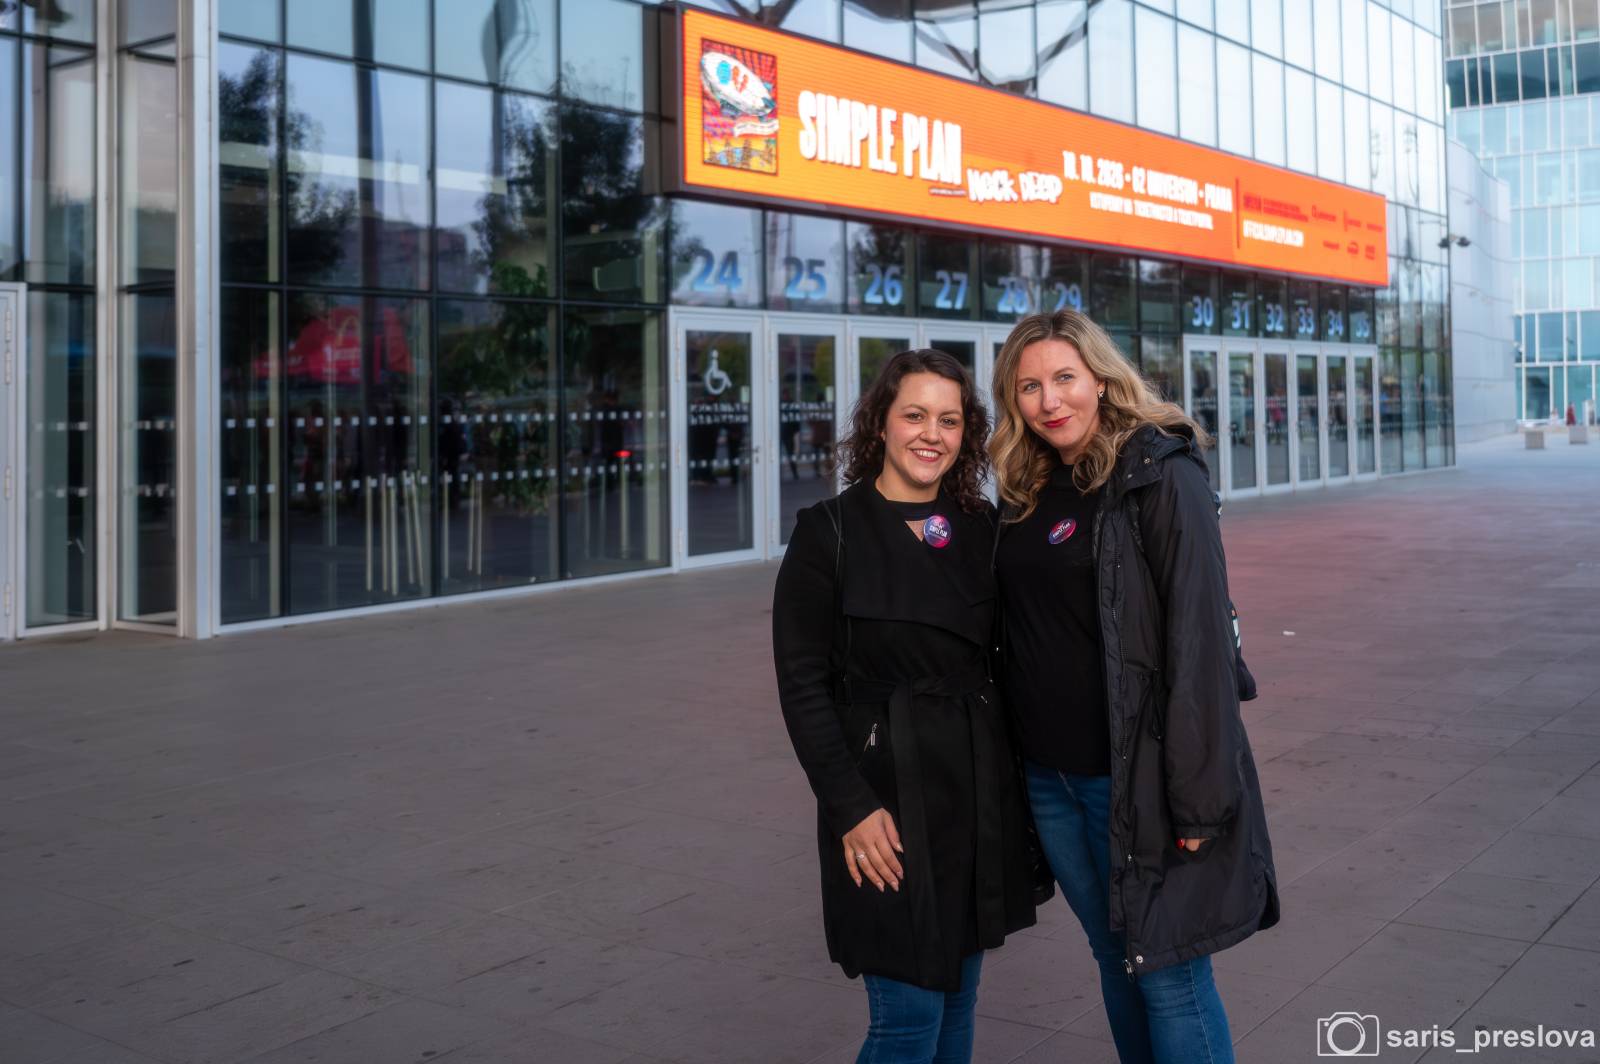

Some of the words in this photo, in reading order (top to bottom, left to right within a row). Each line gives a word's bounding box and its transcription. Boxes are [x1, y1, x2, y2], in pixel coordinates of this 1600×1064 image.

[798, 90, 898, 174] SIMPLE
[902, 112, 962, 185] PLAN
[692, 249, 742, 293] 24
[783, 256, 827, 300] 25
[865, 264, 904, 306] 26
[935, 270, 968, 310] 27
[1055, 282, 1082, 313] 29
[1192, 295, 1214, 328] 30
[1231, 299, 1250, 330] 31
[1266, 303, 1284, 332] 32
[1298, 306, 1315, 334] 33
[1327, 309, 1343, 337] 34
